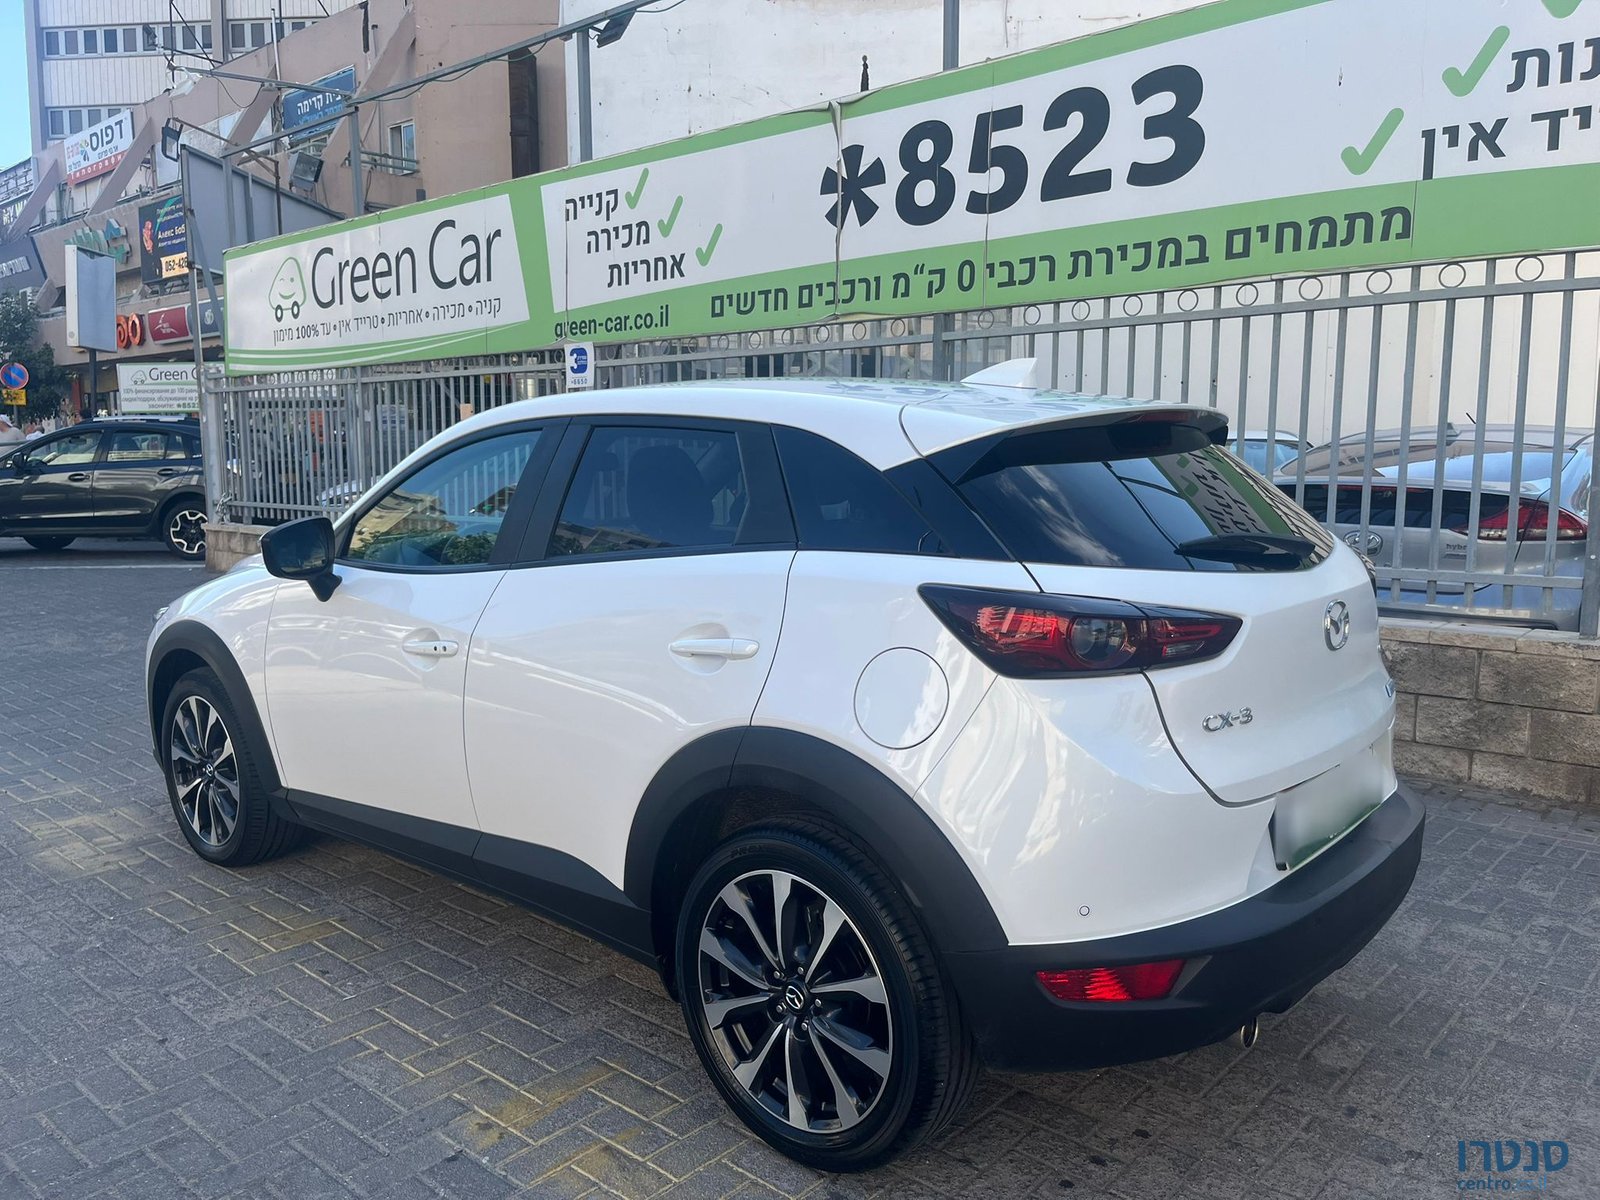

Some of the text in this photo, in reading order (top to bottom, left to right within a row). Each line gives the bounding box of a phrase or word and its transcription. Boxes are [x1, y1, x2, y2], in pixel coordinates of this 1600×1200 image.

[1506, 37, 1600, 93] נות
[296, 94, 323, 115] קדימה
[89, 119, 123, 152] דפוס
[1421, 104, 1600, 181] יד אין
[70, 153, 123, 180] Типографи
[565, 188, 619, 222] קנייה
[175, 223, 186, 235] Боб
[587, 220, 651, 254] מכירה
[1225, 205, 1412, 261] מתמחים
[165, 256, 188, 272] 052-426
[311, 219, 502, 309] Green Car
[607, 252, 686, 288] אחריות
[985, 253, 1056, 290] רכבי
[1067, 233, 1210, 281] במכירת
[798, 275, 881, 309] ורכבים
[957, 259, 975, 292] 0
[710, 287, 789, 318] חדשים
[273, 297, 502, 347] קניה מכירה אחריות טרייד אין עד 100% מימון
[554, 304, 669, 341] green-car.co.il
[149, 367, 188, 380] Green
[1202, 706, 1253, 732] CX-3
